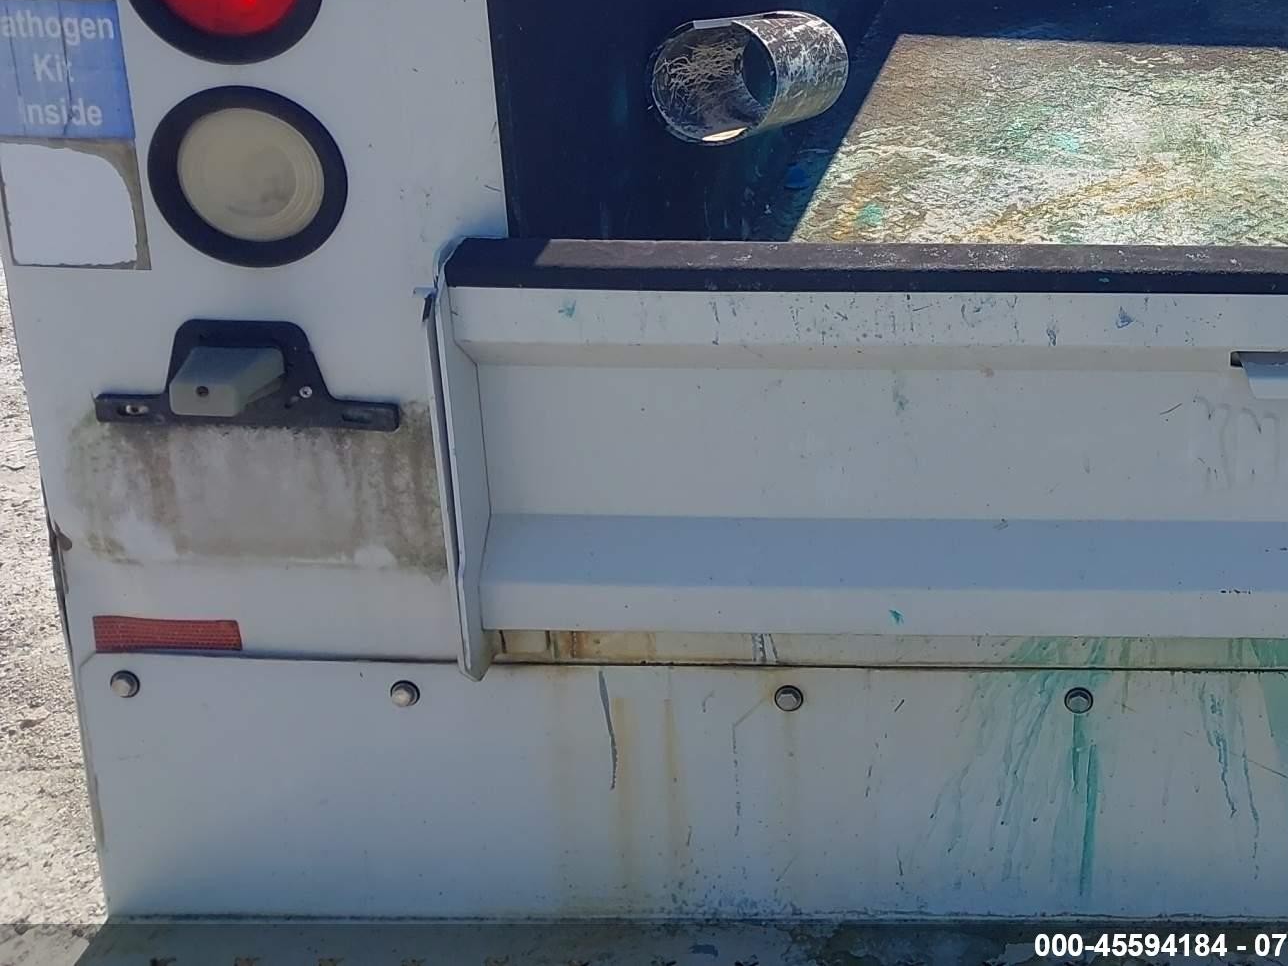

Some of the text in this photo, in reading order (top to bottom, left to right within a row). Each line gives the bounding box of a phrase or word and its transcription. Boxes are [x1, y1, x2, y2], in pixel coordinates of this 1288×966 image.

[0, 10, 115, 46] athogen
[32, 54, 75, 83] Kit
[16, 97, 104, 126] Inside
